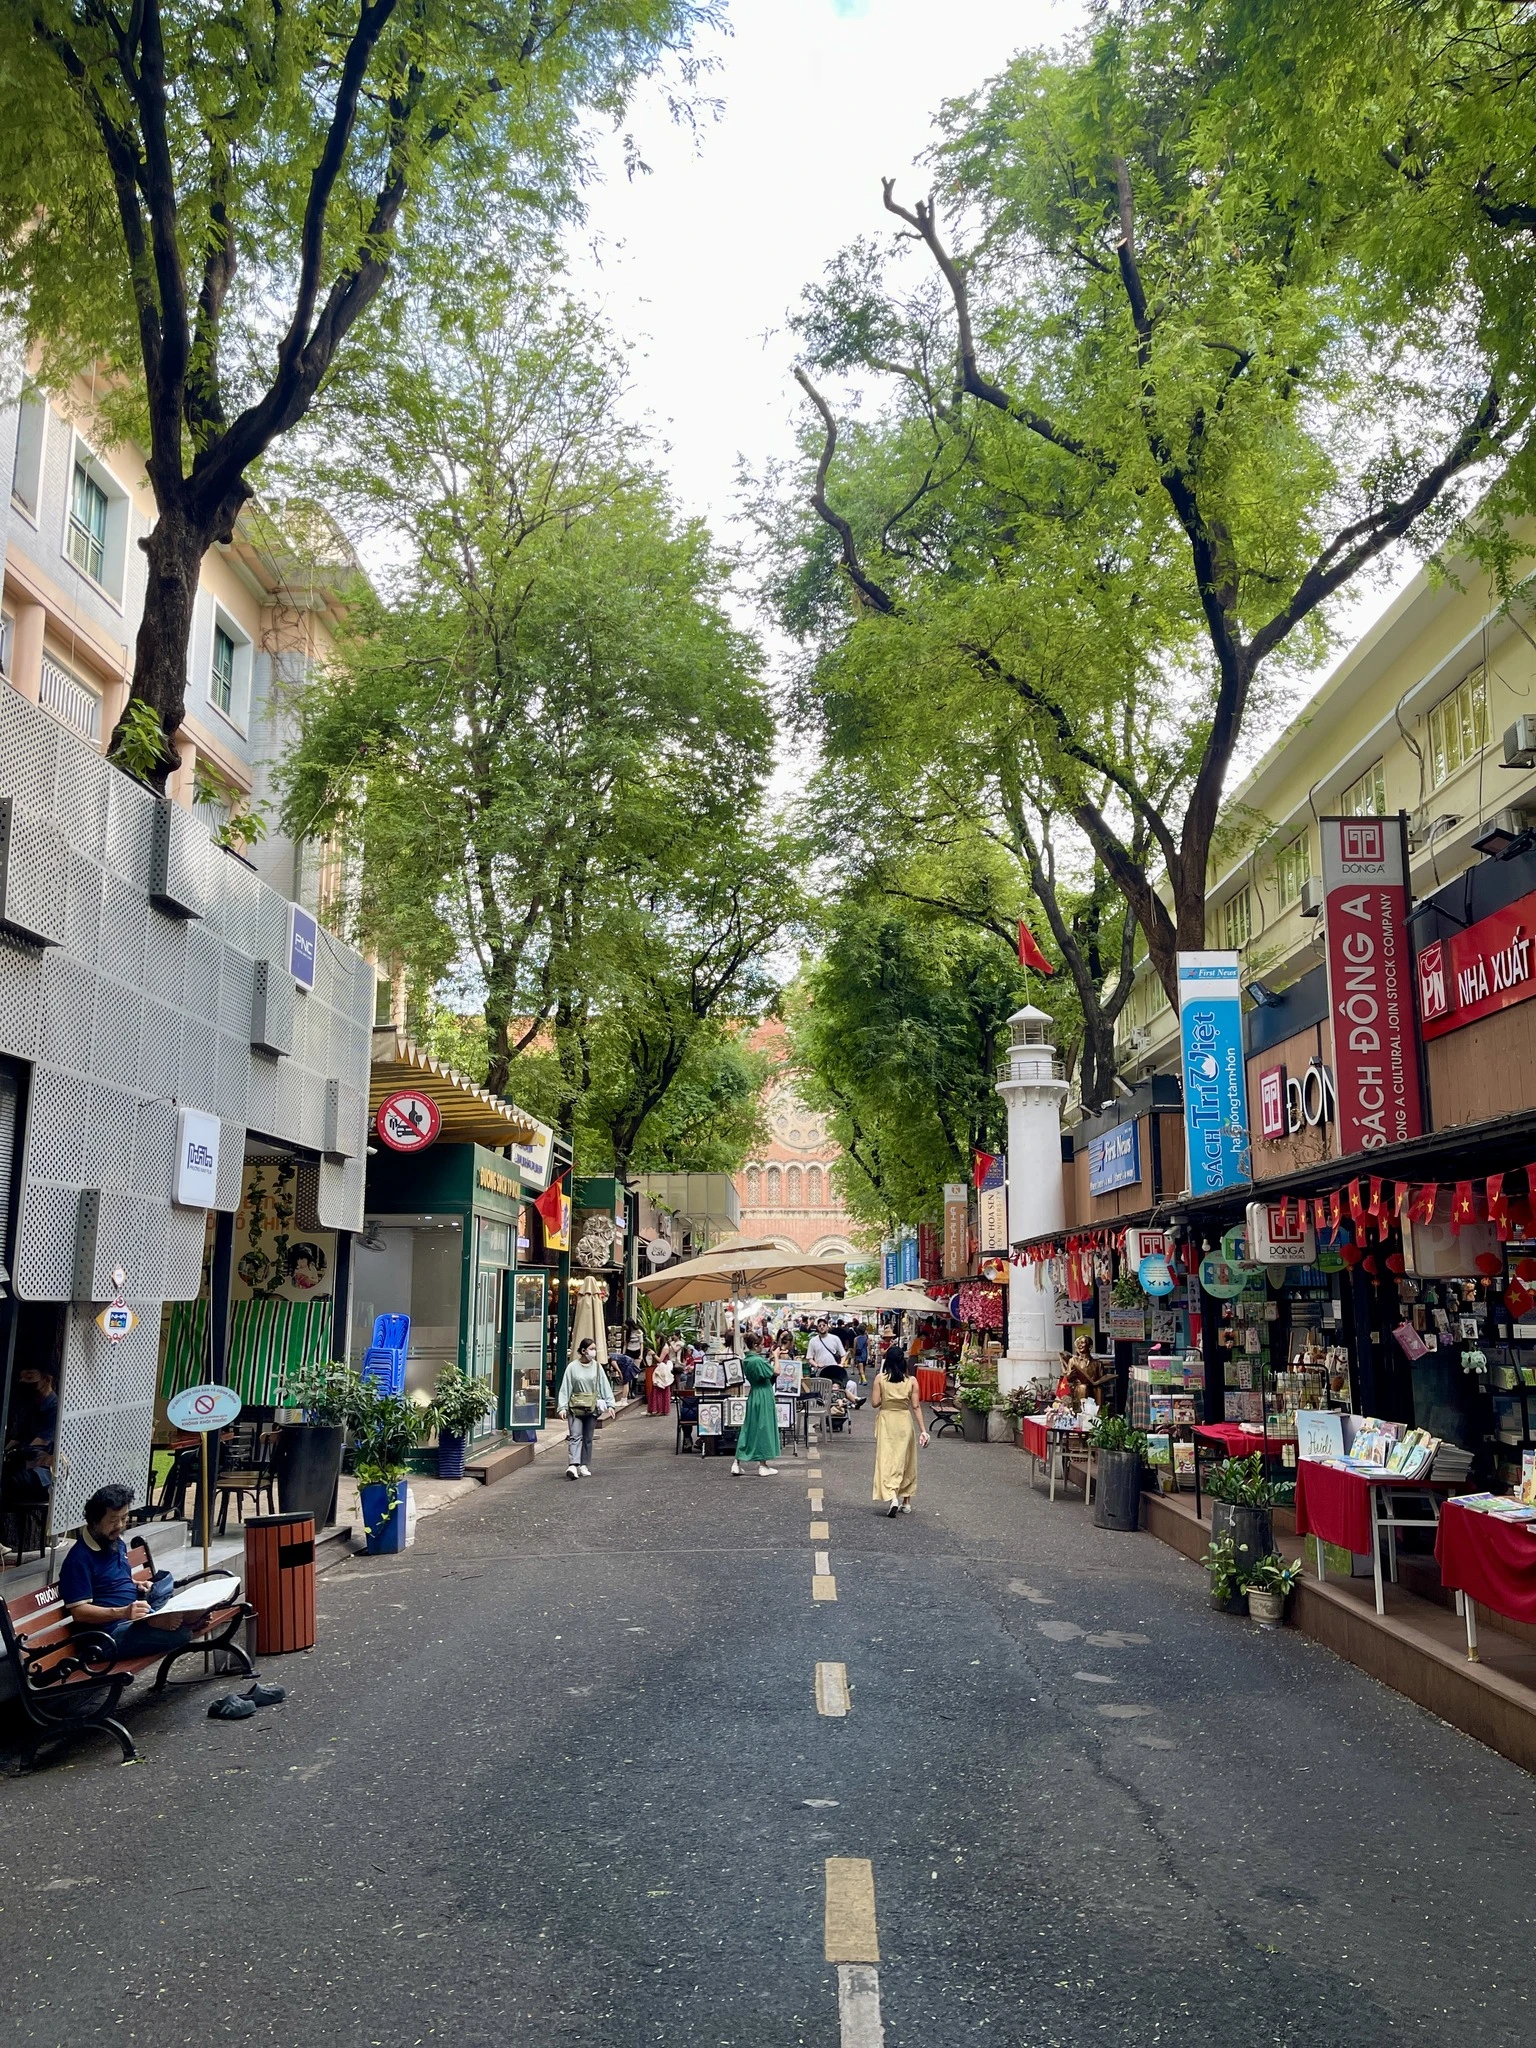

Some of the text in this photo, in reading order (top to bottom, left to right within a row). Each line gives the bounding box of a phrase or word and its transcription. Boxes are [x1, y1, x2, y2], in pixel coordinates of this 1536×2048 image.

[1380, 893, 1395, 957] COMPANY
[1384, 960, 1398, 1000] STOCK
[1458, 954, 1490, 1008] NHÀ
[1490, 926, 1530, 993] XUẤT
[1339, 893, 1387, 1149] SÁCH ĐÔNG A
[1388, 1002, 1400, 1032] JOIN
[1391, 1034, 1407, 1094] CULTURAL
[1394, 1097, 1406, 1107] A
[1202, 1129, 1225, 1187] SÁCH
[987, 1212, 996, 1230] HOA
[1307, 1431, 1333, 1455] Heidi
